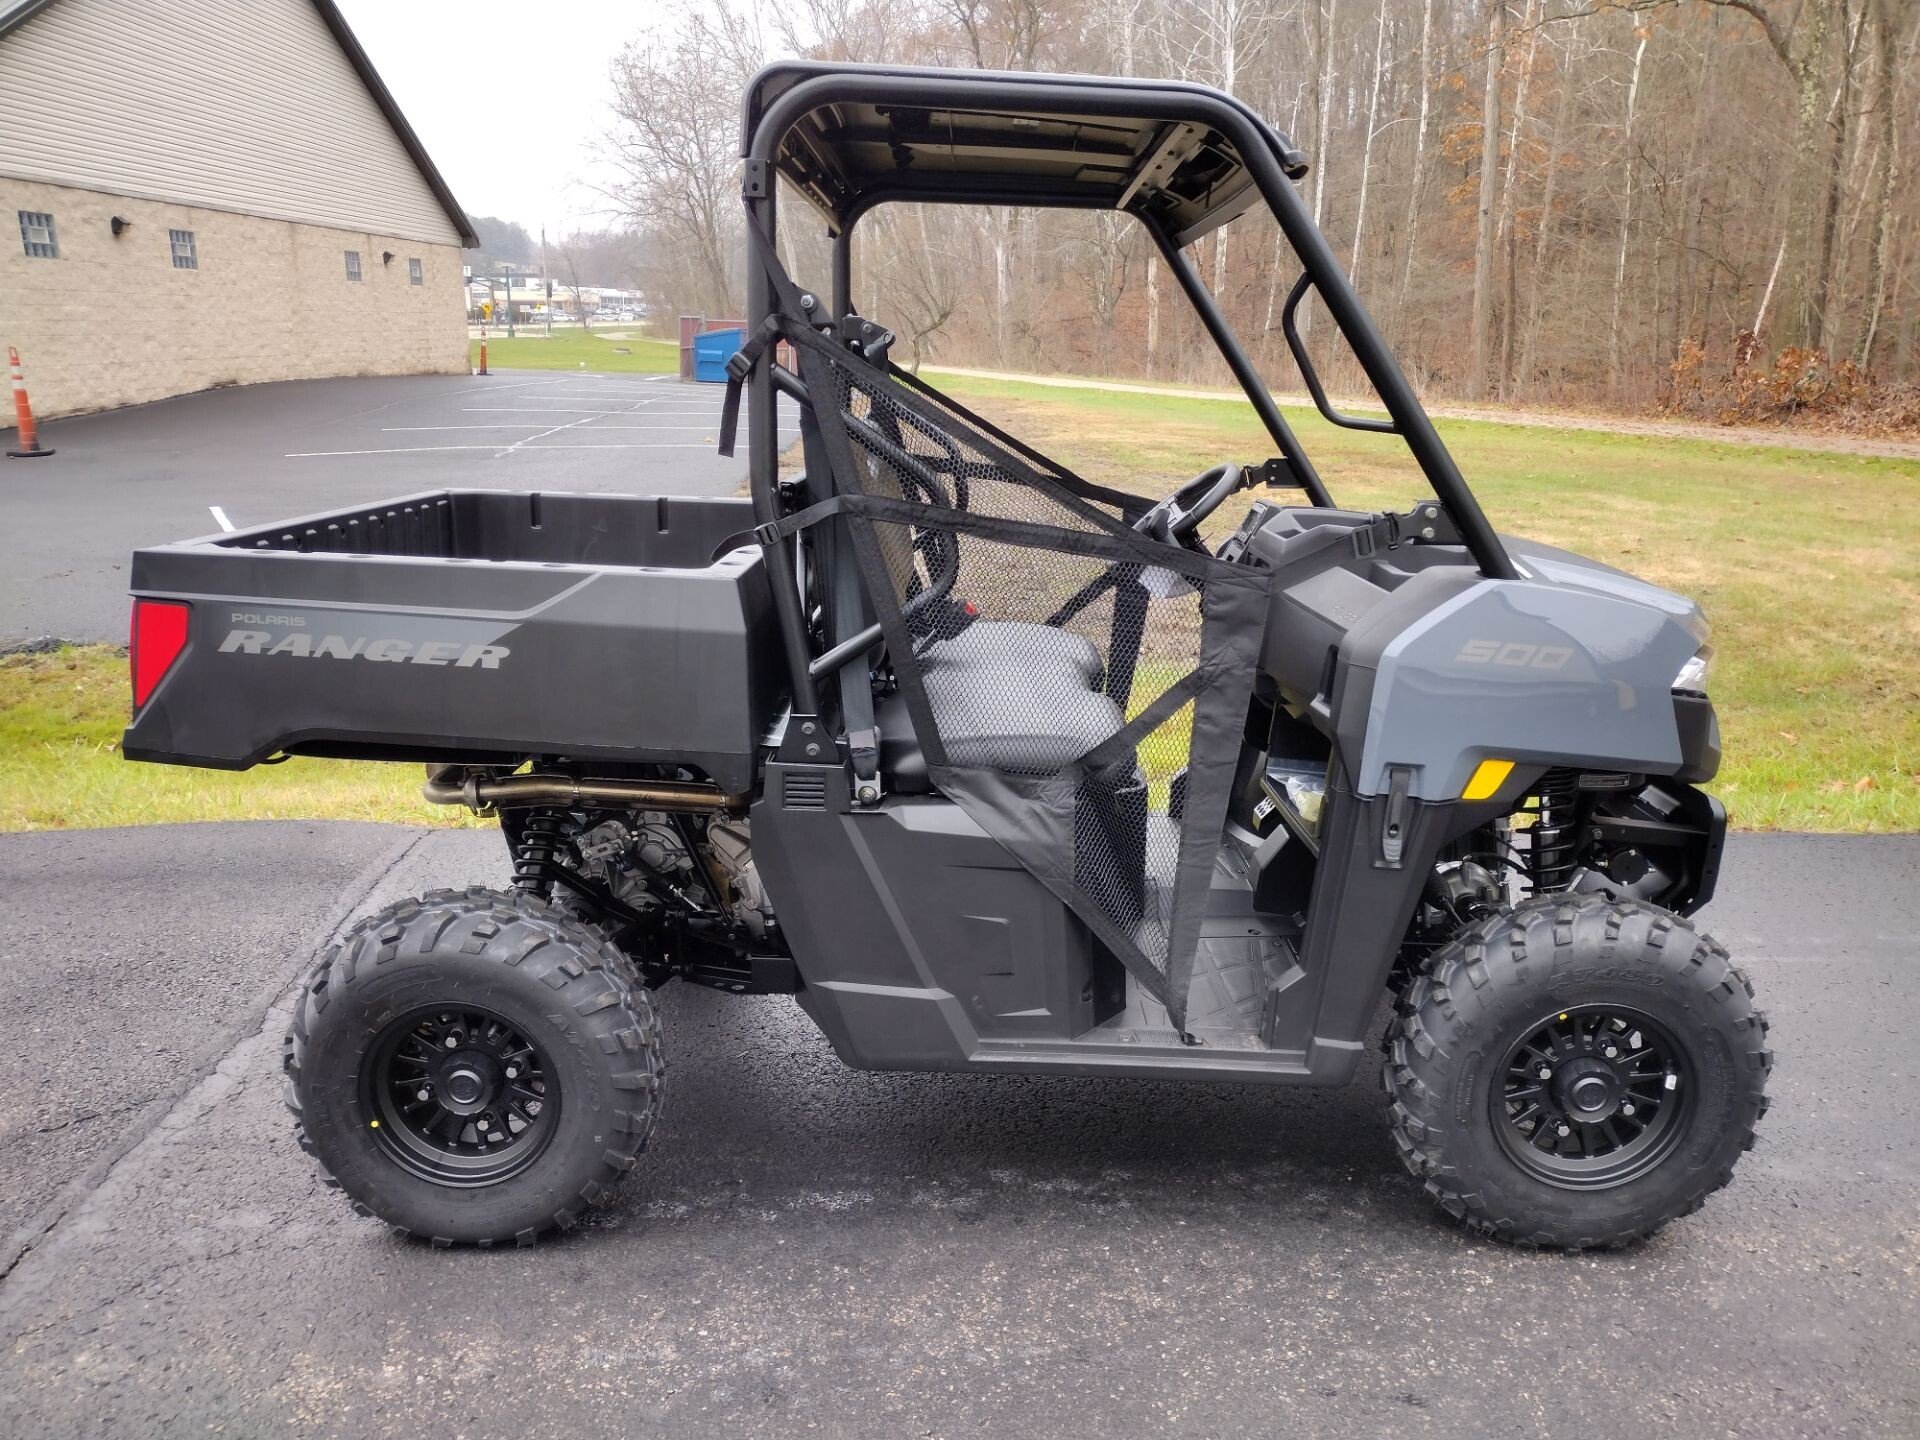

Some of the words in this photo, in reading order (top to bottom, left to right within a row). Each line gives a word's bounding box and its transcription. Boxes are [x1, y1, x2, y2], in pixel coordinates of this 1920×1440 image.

[231, 612, 306, 627] POLARIS
[217, 629, 511, 669] RANGER
[1455, 639, 1575, 669] 500
